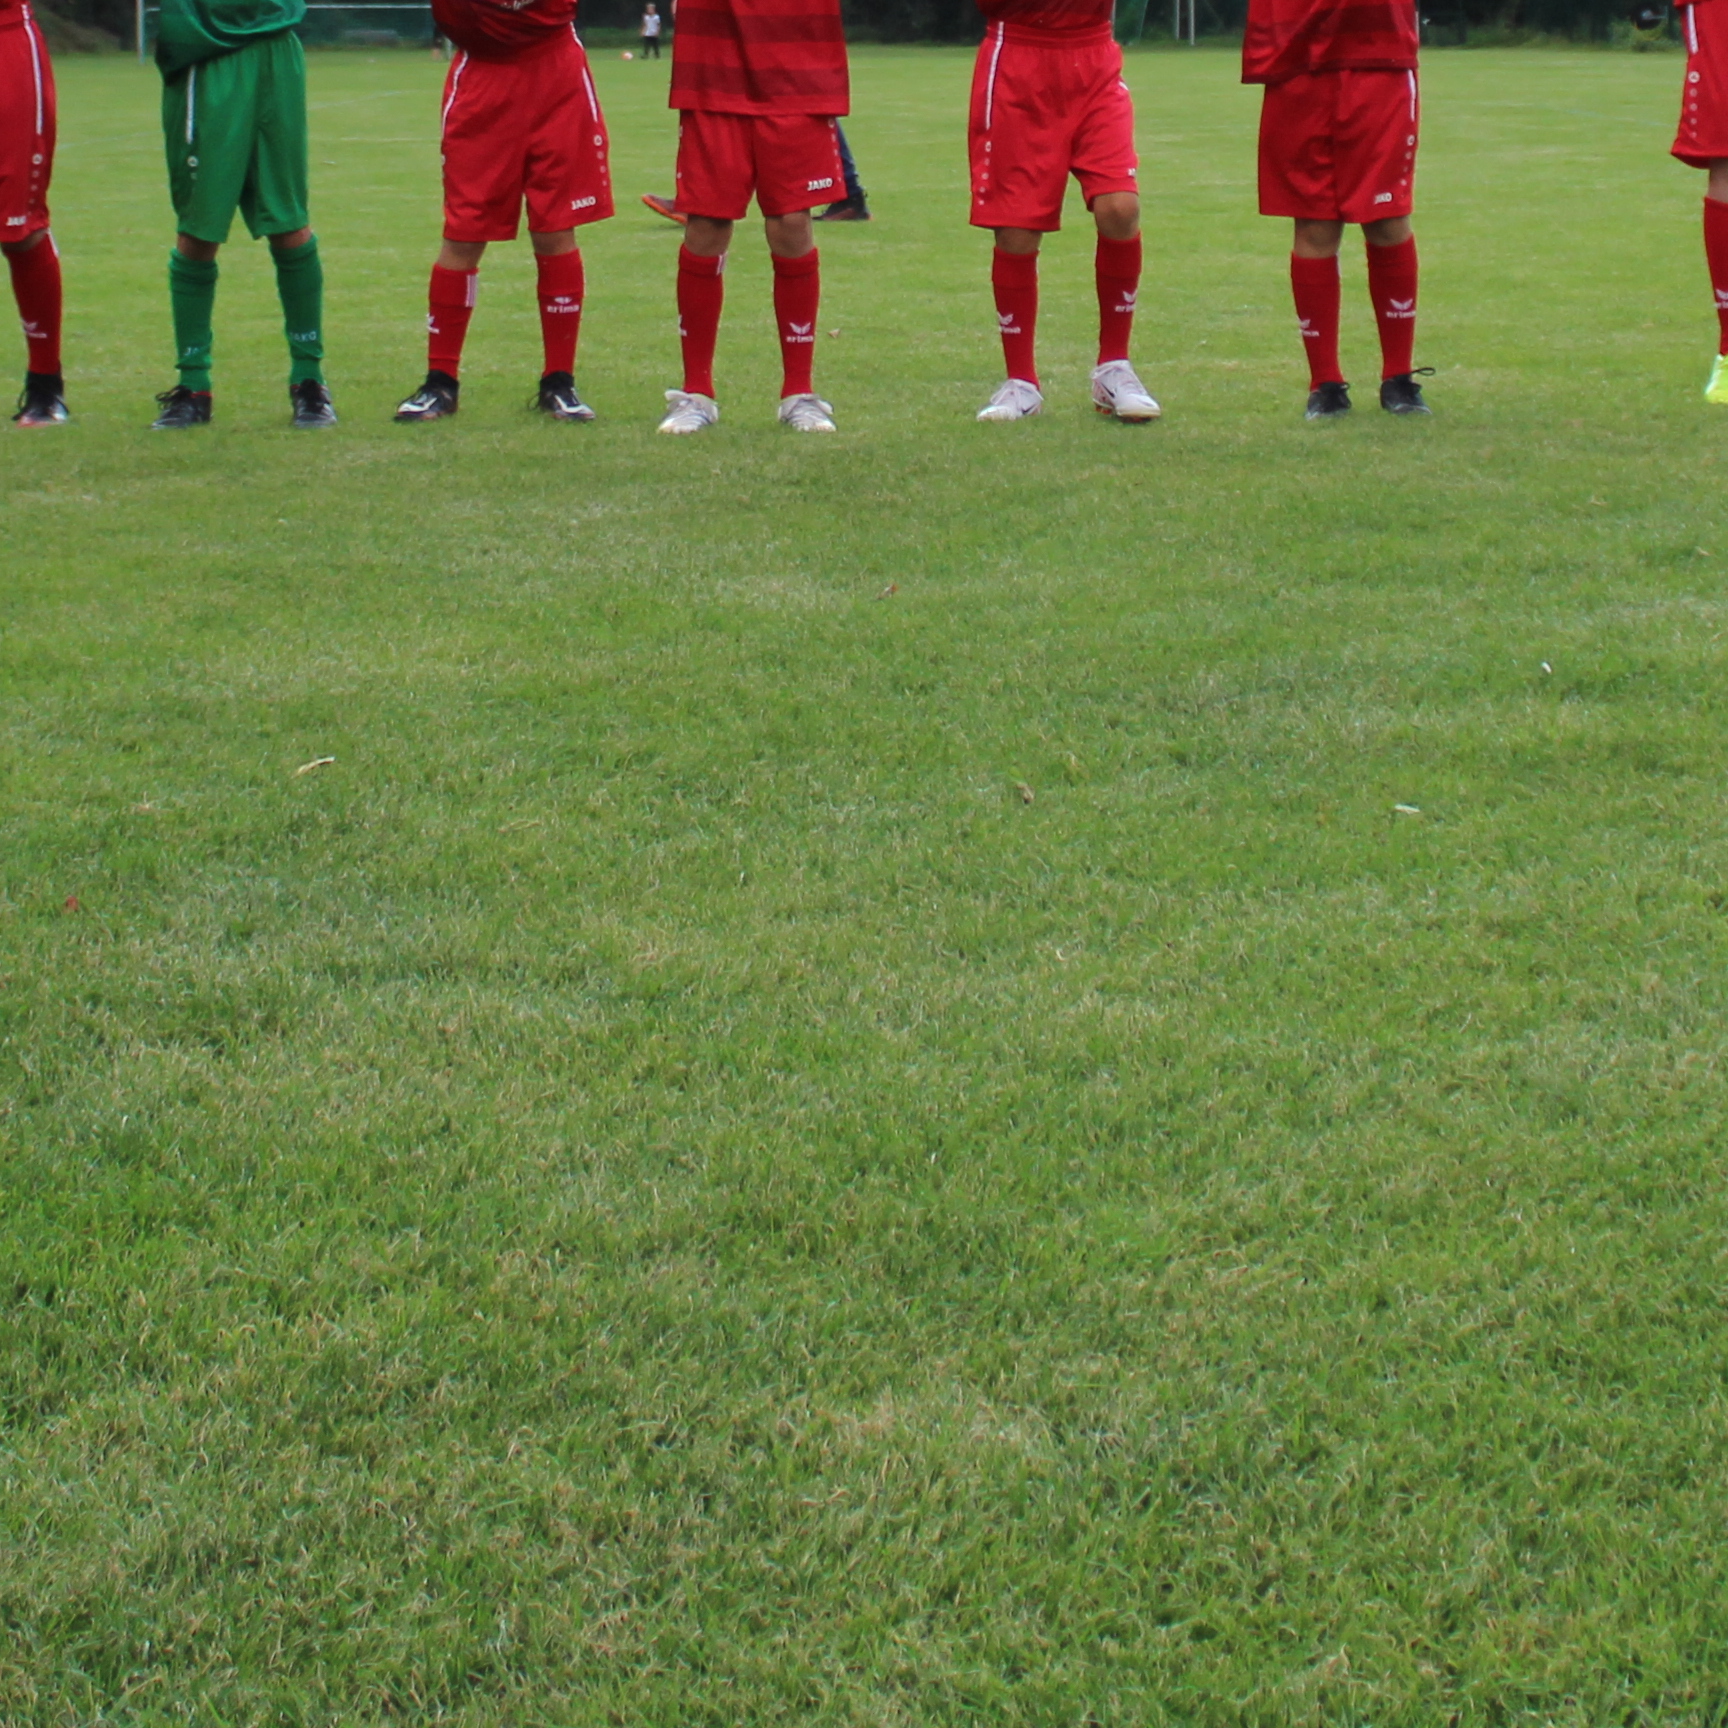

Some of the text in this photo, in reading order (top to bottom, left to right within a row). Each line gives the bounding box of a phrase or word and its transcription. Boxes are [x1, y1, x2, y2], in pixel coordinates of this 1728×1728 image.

[807, 178, 834, 191] JAKO
[571, 196, 597, 210] JAKO
[547, 304, 580, 314] erima
